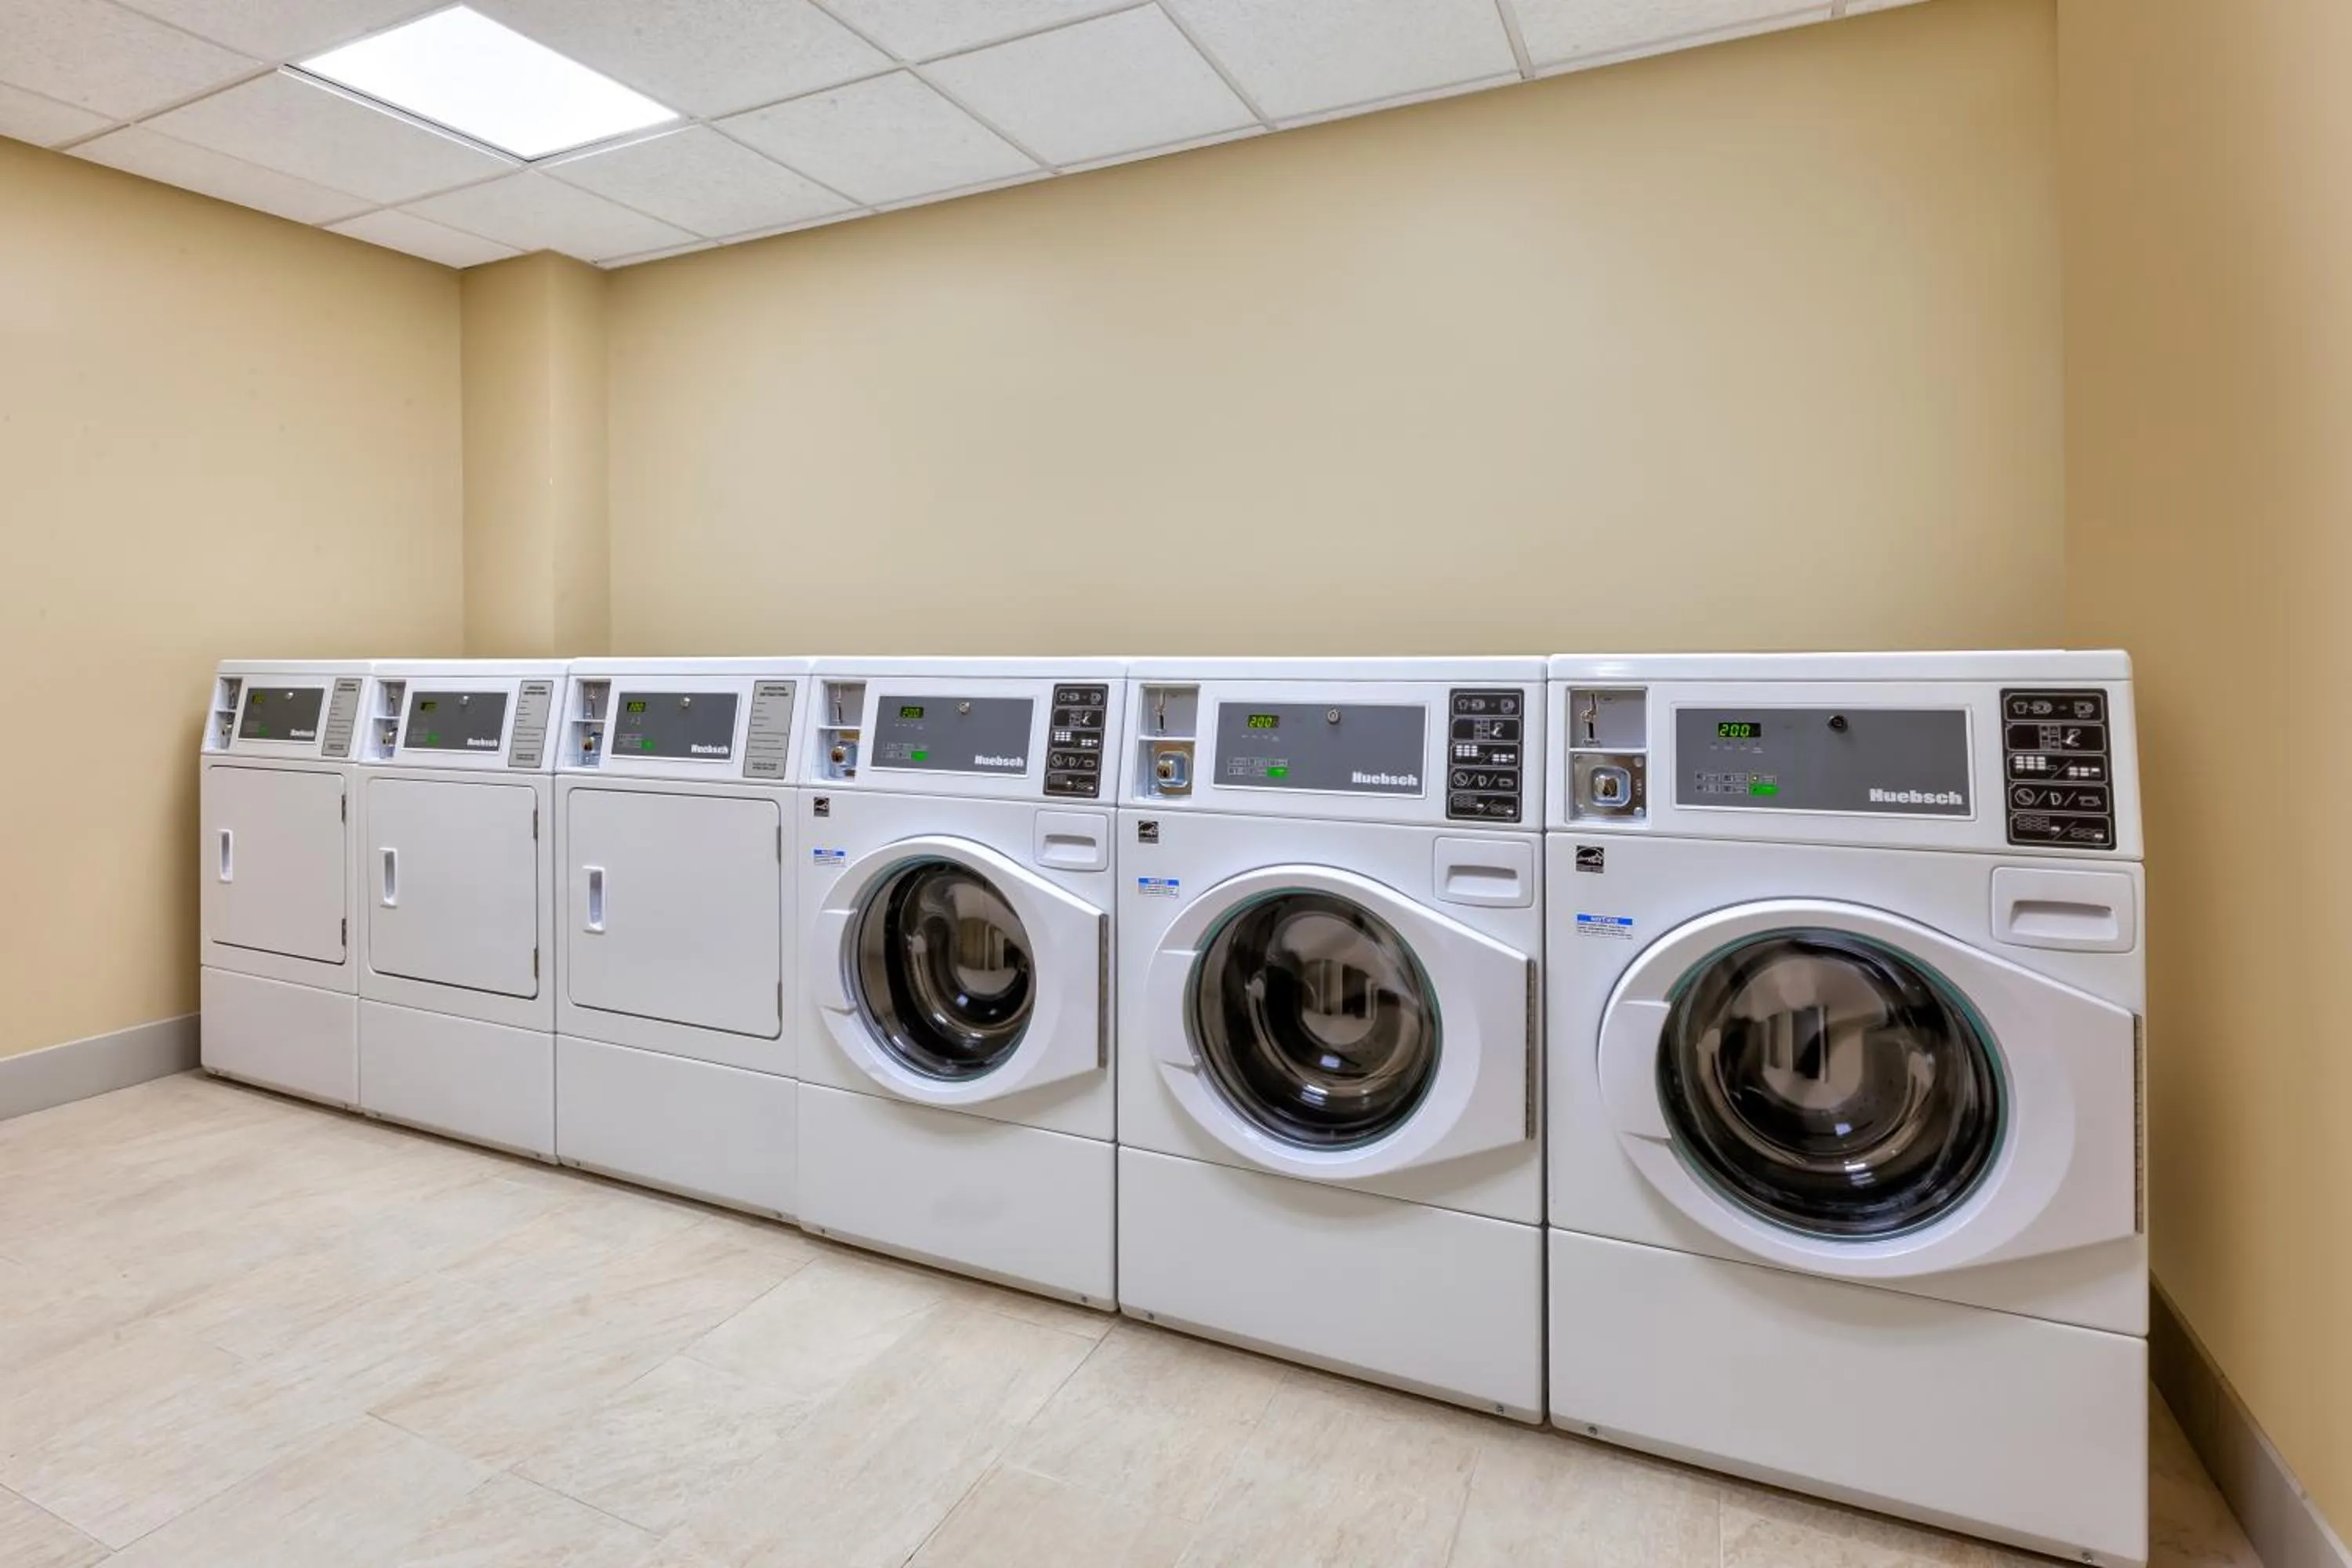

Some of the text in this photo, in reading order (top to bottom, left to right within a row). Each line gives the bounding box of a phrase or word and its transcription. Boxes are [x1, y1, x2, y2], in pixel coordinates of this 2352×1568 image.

[1719, 724, 1750, 736] 200
[975, 754, 1024, 768] Huebsch
[1352, 771, 1418, 786] Huebsch
[1869, 788, 1964, 805] Huebsch
